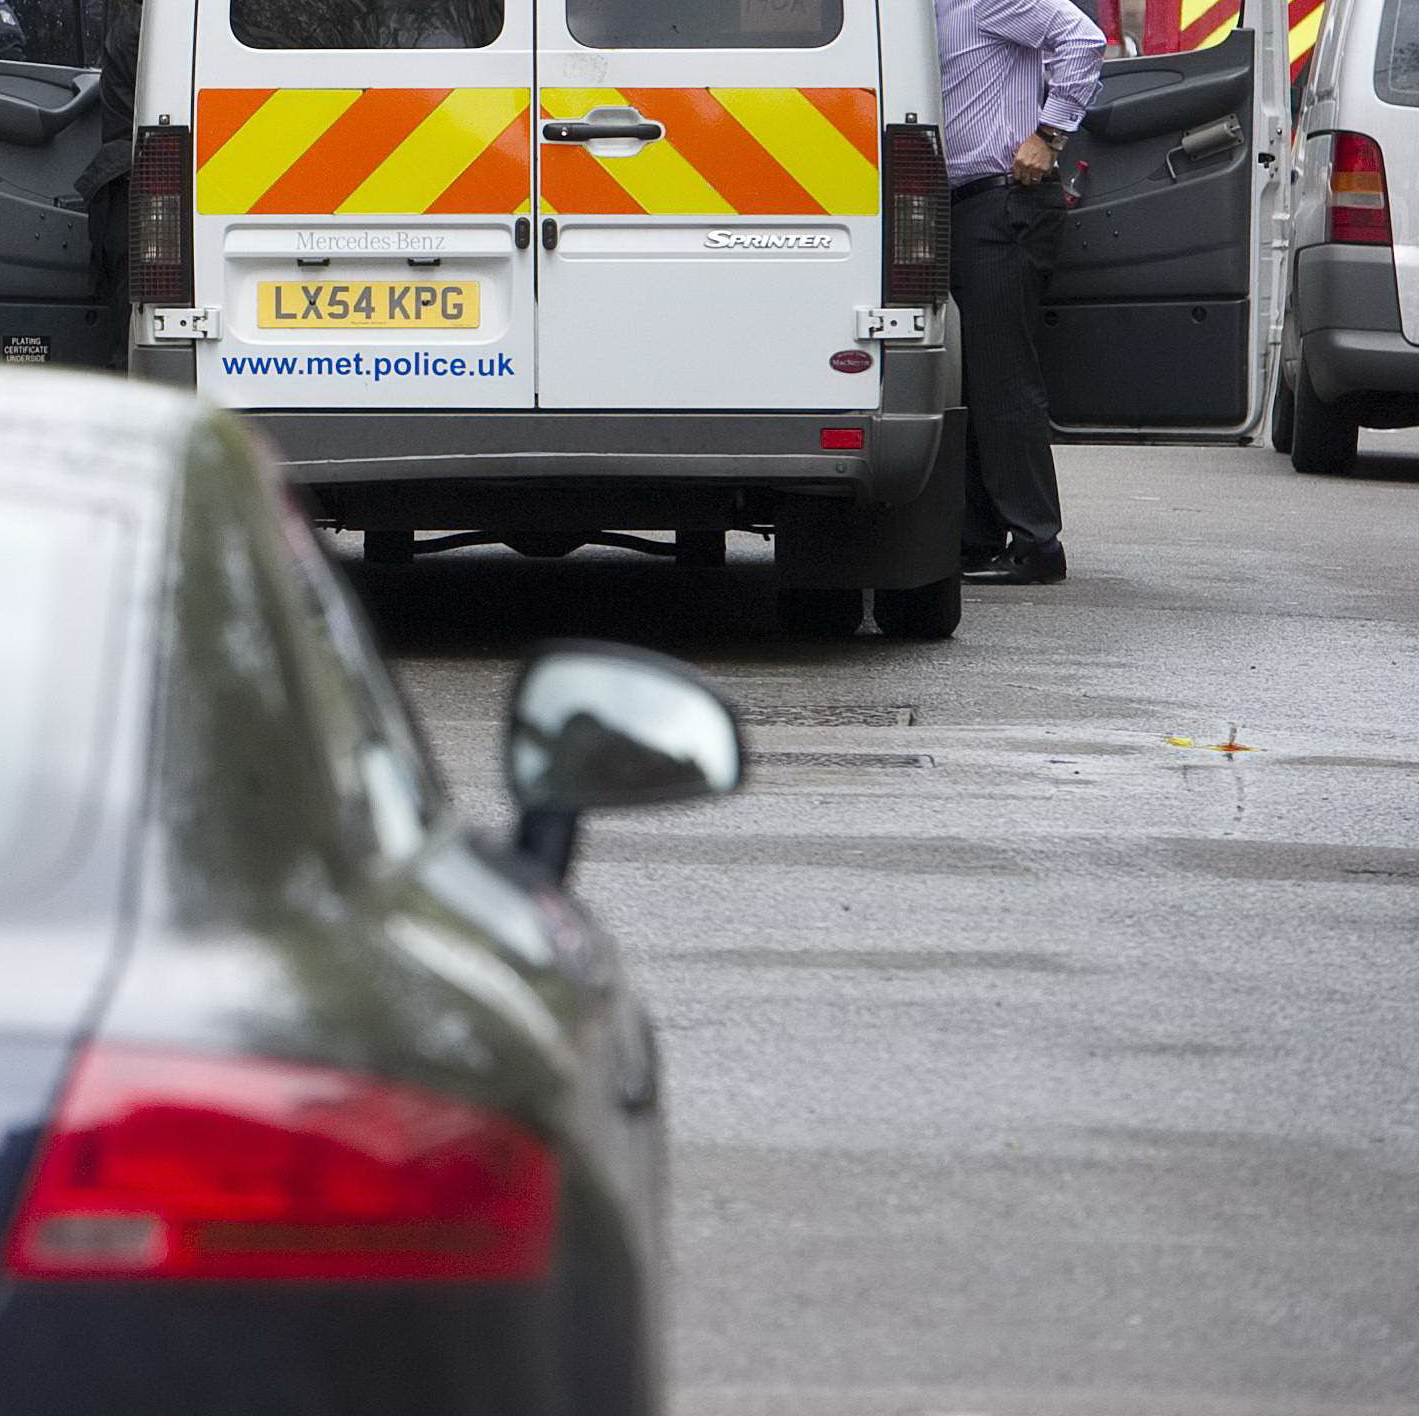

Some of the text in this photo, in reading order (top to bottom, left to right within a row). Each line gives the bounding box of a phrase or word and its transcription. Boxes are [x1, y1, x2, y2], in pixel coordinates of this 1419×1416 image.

[296, 231, 446, 251] Mercedes-Benz
[704, 229, 832, 249] SPRINTER
[274, 286, 464, 320] LX54 KPG
[4, 346, 49, 354] CERTIFICATE
[11, 337, 41, 345] PLATING
[222, 351, 515, 381] www.met.police.uk
